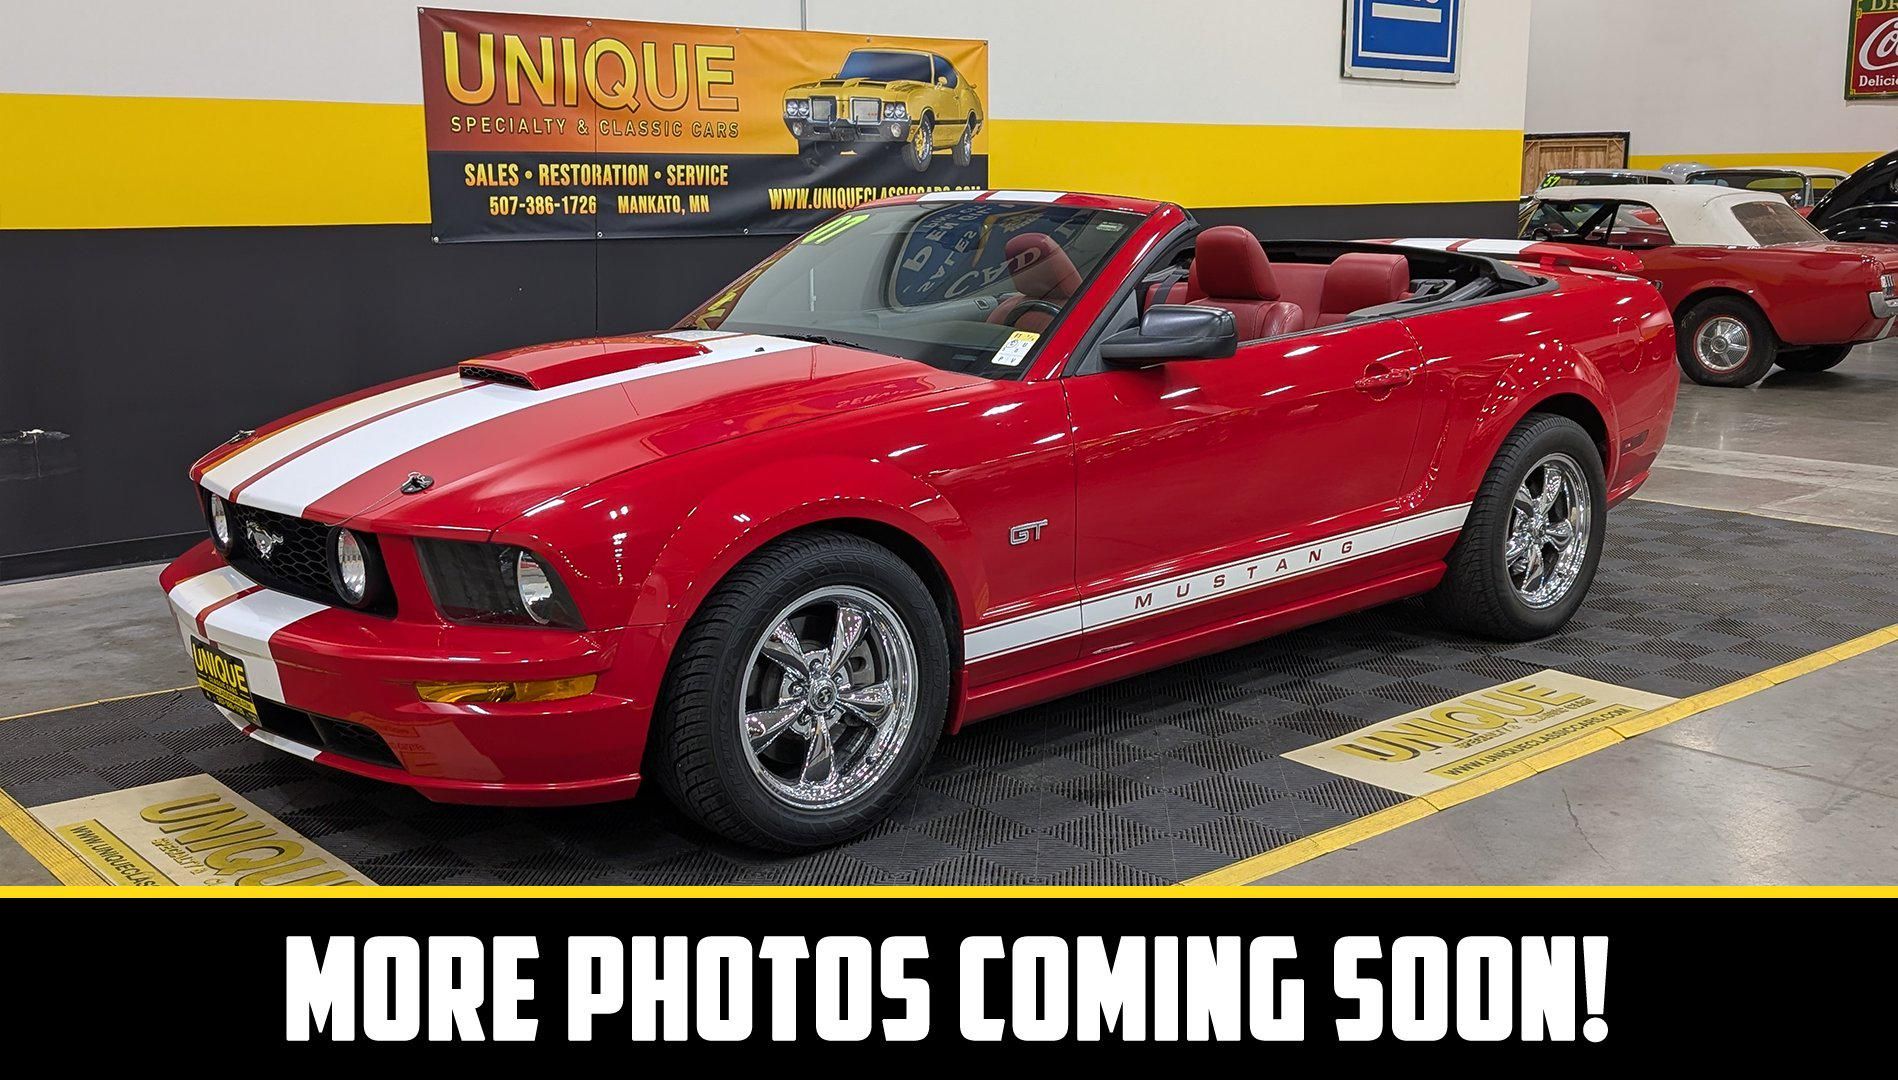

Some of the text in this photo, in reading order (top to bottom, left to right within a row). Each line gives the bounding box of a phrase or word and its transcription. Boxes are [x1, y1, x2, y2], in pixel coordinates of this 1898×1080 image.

[442, 30, 740, 113] UNIQUE
[451, 116, 739, 138] SPECIALTY & CLASSIC CARS
[464, 163, 729, 187] SALES RESTORATION SERVICE
[490, 195, 710, 216] 507-386-1726 MANKATO, MN
[1009, 519, 1048, 545] GT
[1134, 541, 1353, 610] MUSTANG
[192, 643, 249, 694] UNIQUE
[1332, 682, 1586, 763] UNIQUE
[140, 793, 363, 886] UNIQU
